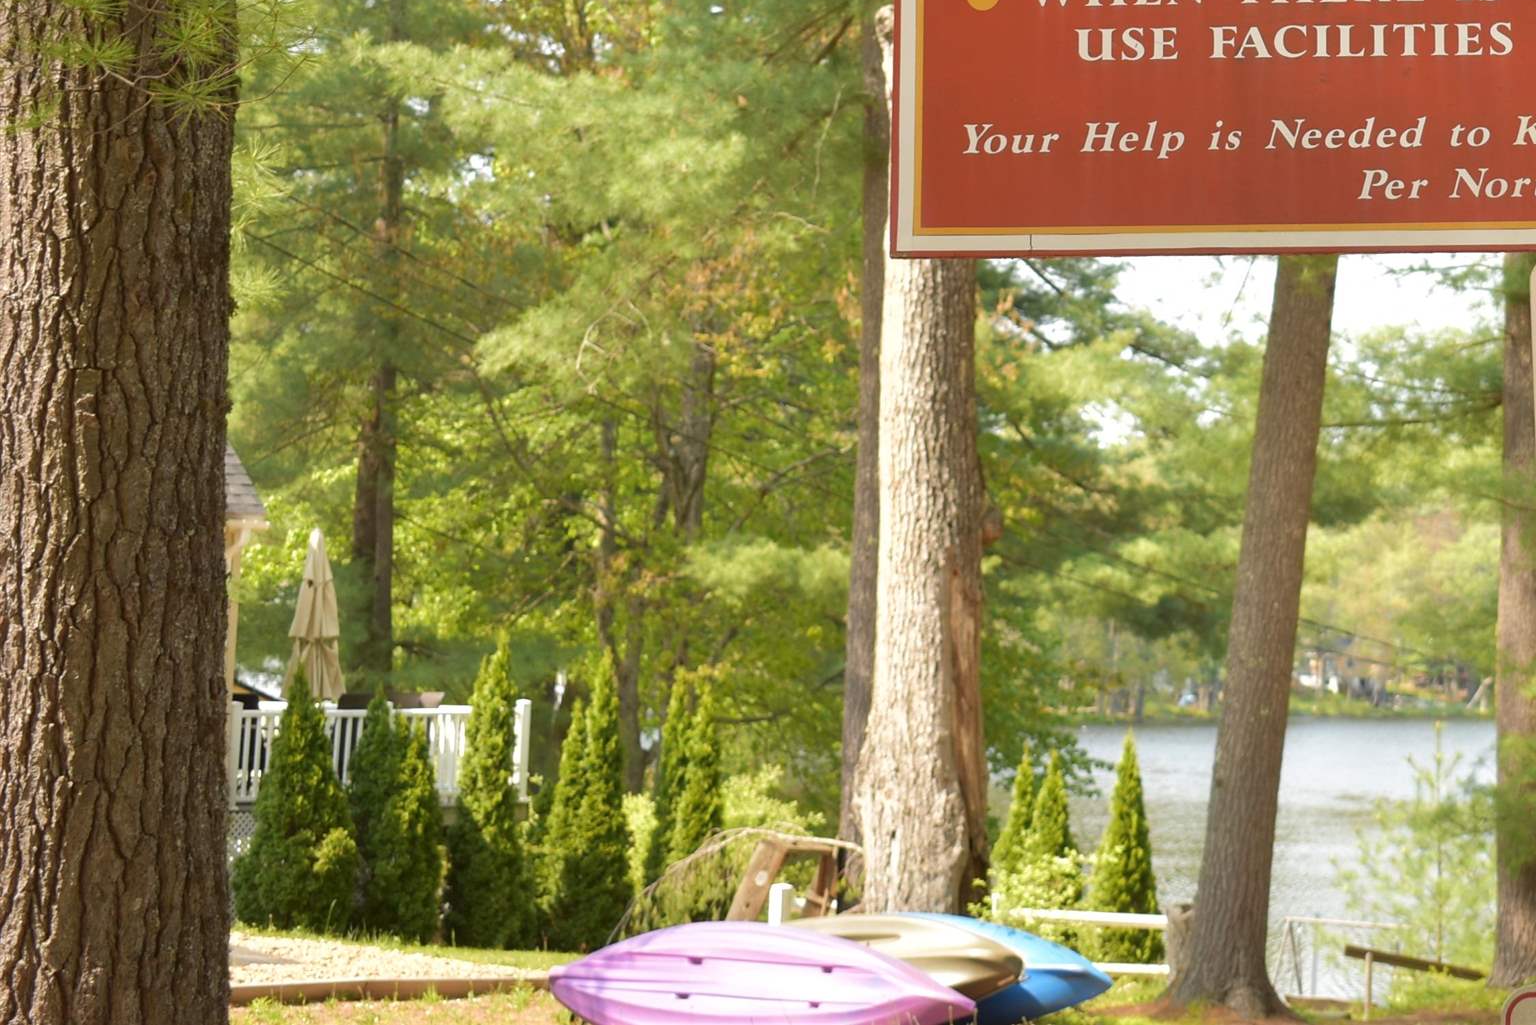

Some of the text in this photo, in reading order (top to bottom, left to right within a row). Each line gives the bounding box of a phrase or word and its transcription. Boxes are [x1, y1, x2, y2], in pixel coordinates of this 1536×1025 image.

[1076, 27, 1179, 62] USE
[1210, 22, 1513, 59] FACILITIES
[964, 123, 1060, 154] Your
[1081, 120, 1185, 159] Help
[1209, 120, 1242, 151] is
[1265, 116, 1427, 149] Needed
[1450, 124, 1491, 147] to
[1359, 169, 1429, 200] Per
